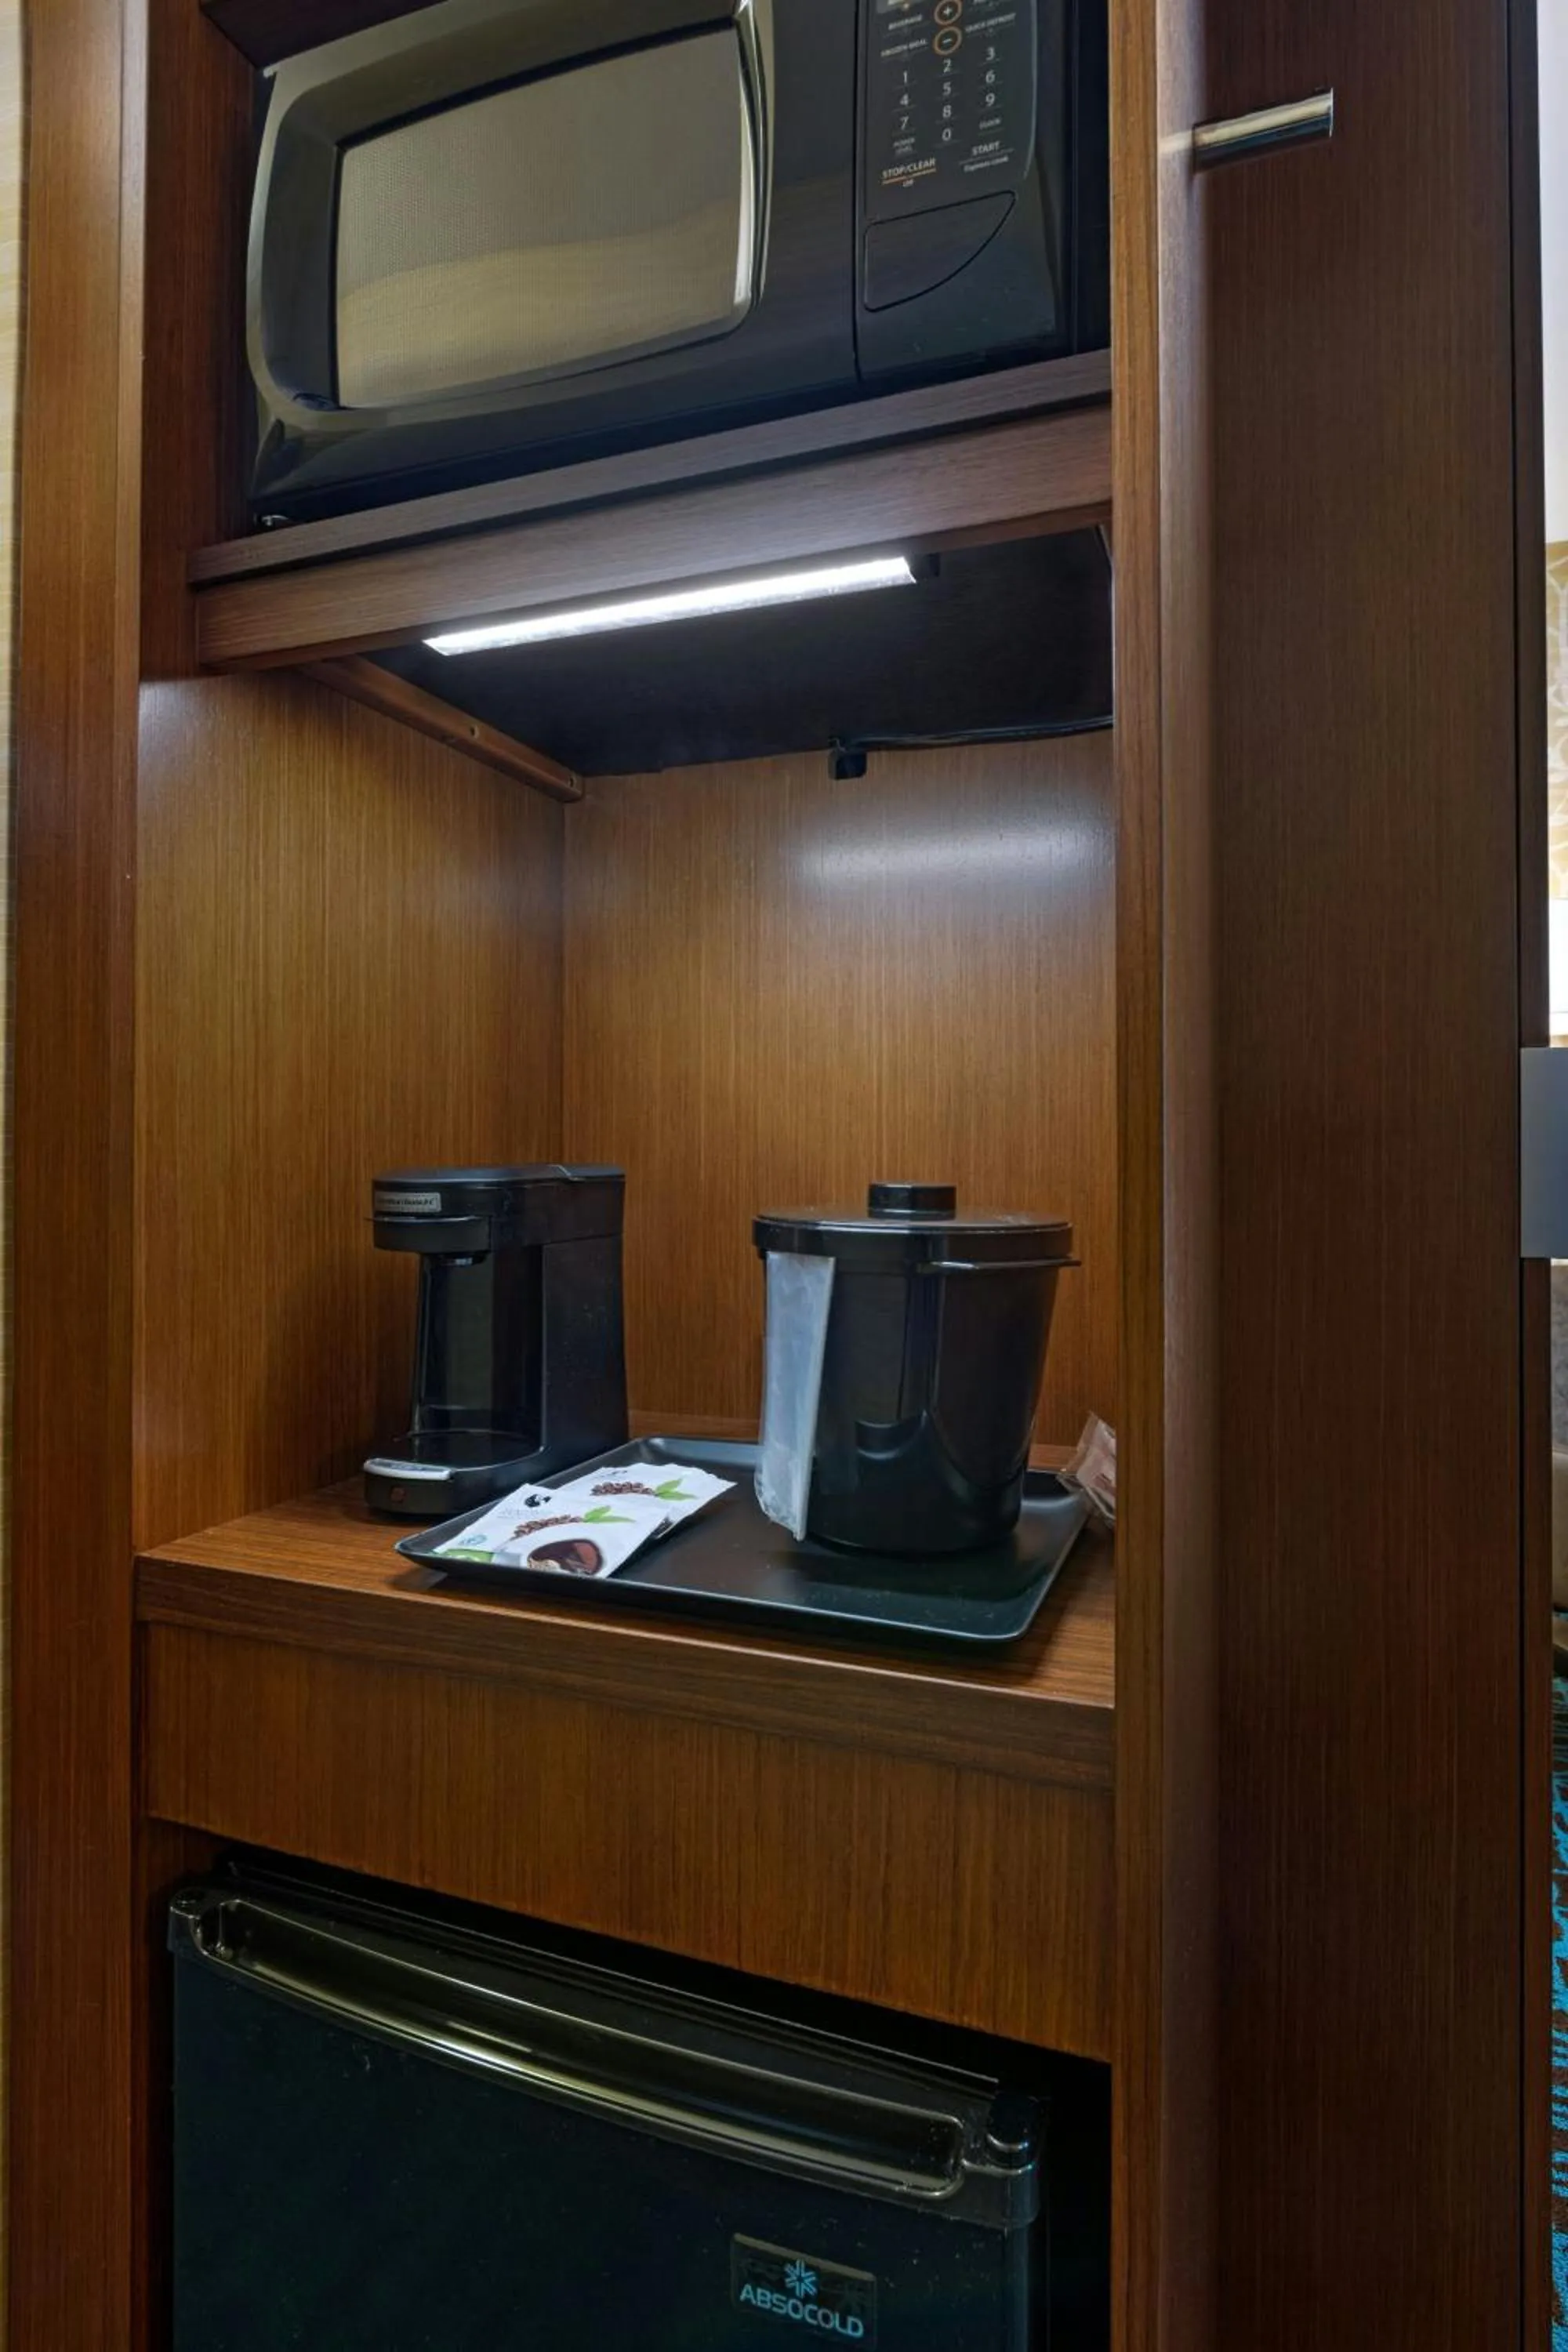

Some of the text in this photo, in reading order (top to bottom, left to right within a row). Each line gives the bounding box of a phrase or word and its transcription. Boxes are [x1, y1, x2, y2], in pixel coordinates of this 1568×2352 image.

[943, 59, 952, 73] 2
[986, 47, 996, 60] 3
[900, 70, 995, 107] 4 5 6
[900, 93, 995, 130] 7 8 9
[942, 129, 952, 141] 0
[972, 141, 1000, 156] START
[882, 158, 936, 179] STOP/CLEAR
[740, 2283, 864, 2338] ABSOCOLD
